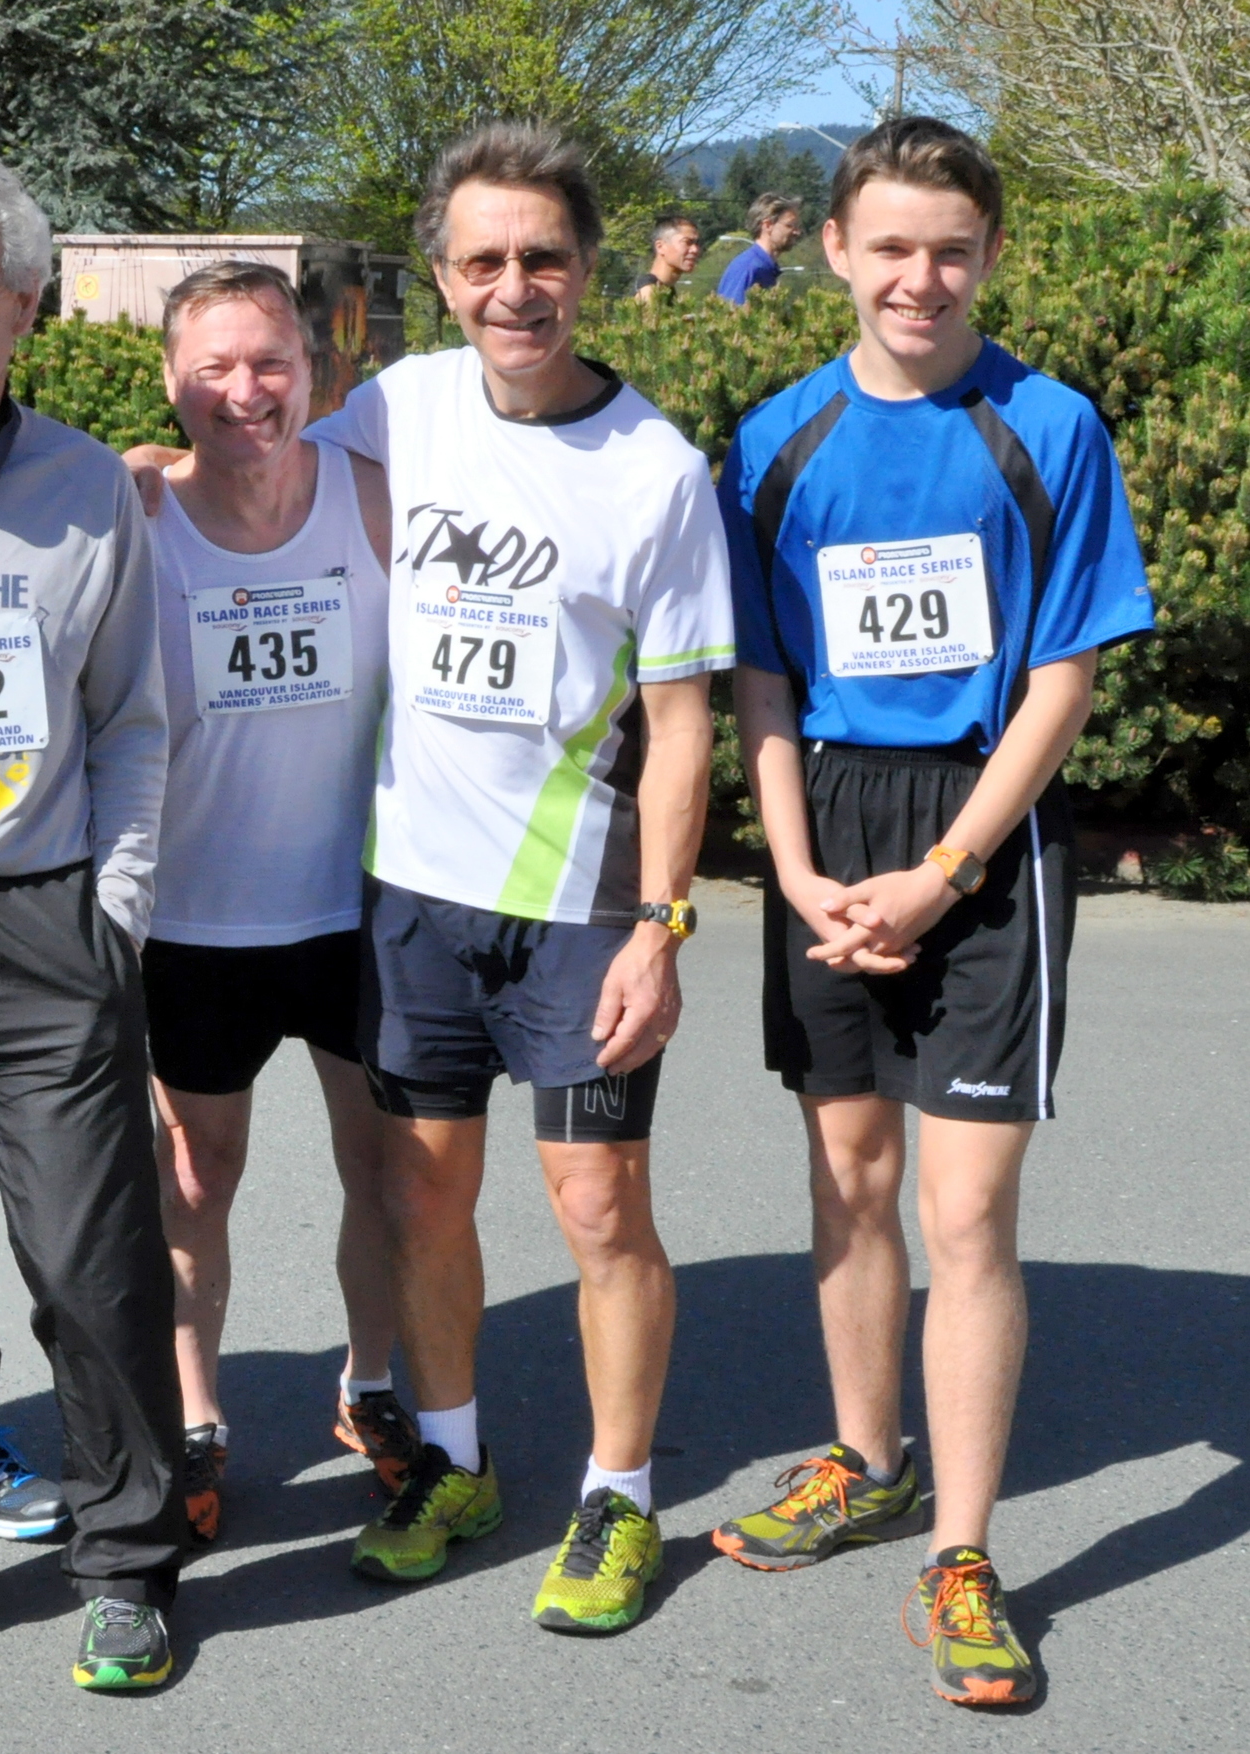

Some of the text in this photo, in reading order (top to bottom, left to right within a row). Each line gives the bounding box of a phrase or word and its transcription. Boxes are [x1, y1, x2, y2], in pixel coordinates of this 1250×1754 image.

[828, 557, 973, 581] ISLAND RACE SERIES
[197, 599, 341, 623] ISLAND RACE SERIES
[416, 602, 549, 628] ISLAND RACE SERIES
[859, 589, 950, 643] 429
[227, 628, 318, 682] 435
[432, 633, 516, 690] 479
[842, 659, 895, 671] RUNNERS'
[899, 652, 979, 668] ASSOCIATION
[852, 643, 966, 660] VANCOUVER ISLAND
[208, 697, 266, 709] RUNNERS'
[268, 687, 341, 705] ASSOCIATION
[219, 680, 331, 699] VANCOUVER ISLAND
[422, 686, 525, 707] VANCOUVER ISLAND
[414, 694, 455, 709] RUNNERS'
[457, 701, 536, 719] ASSOCIATION
